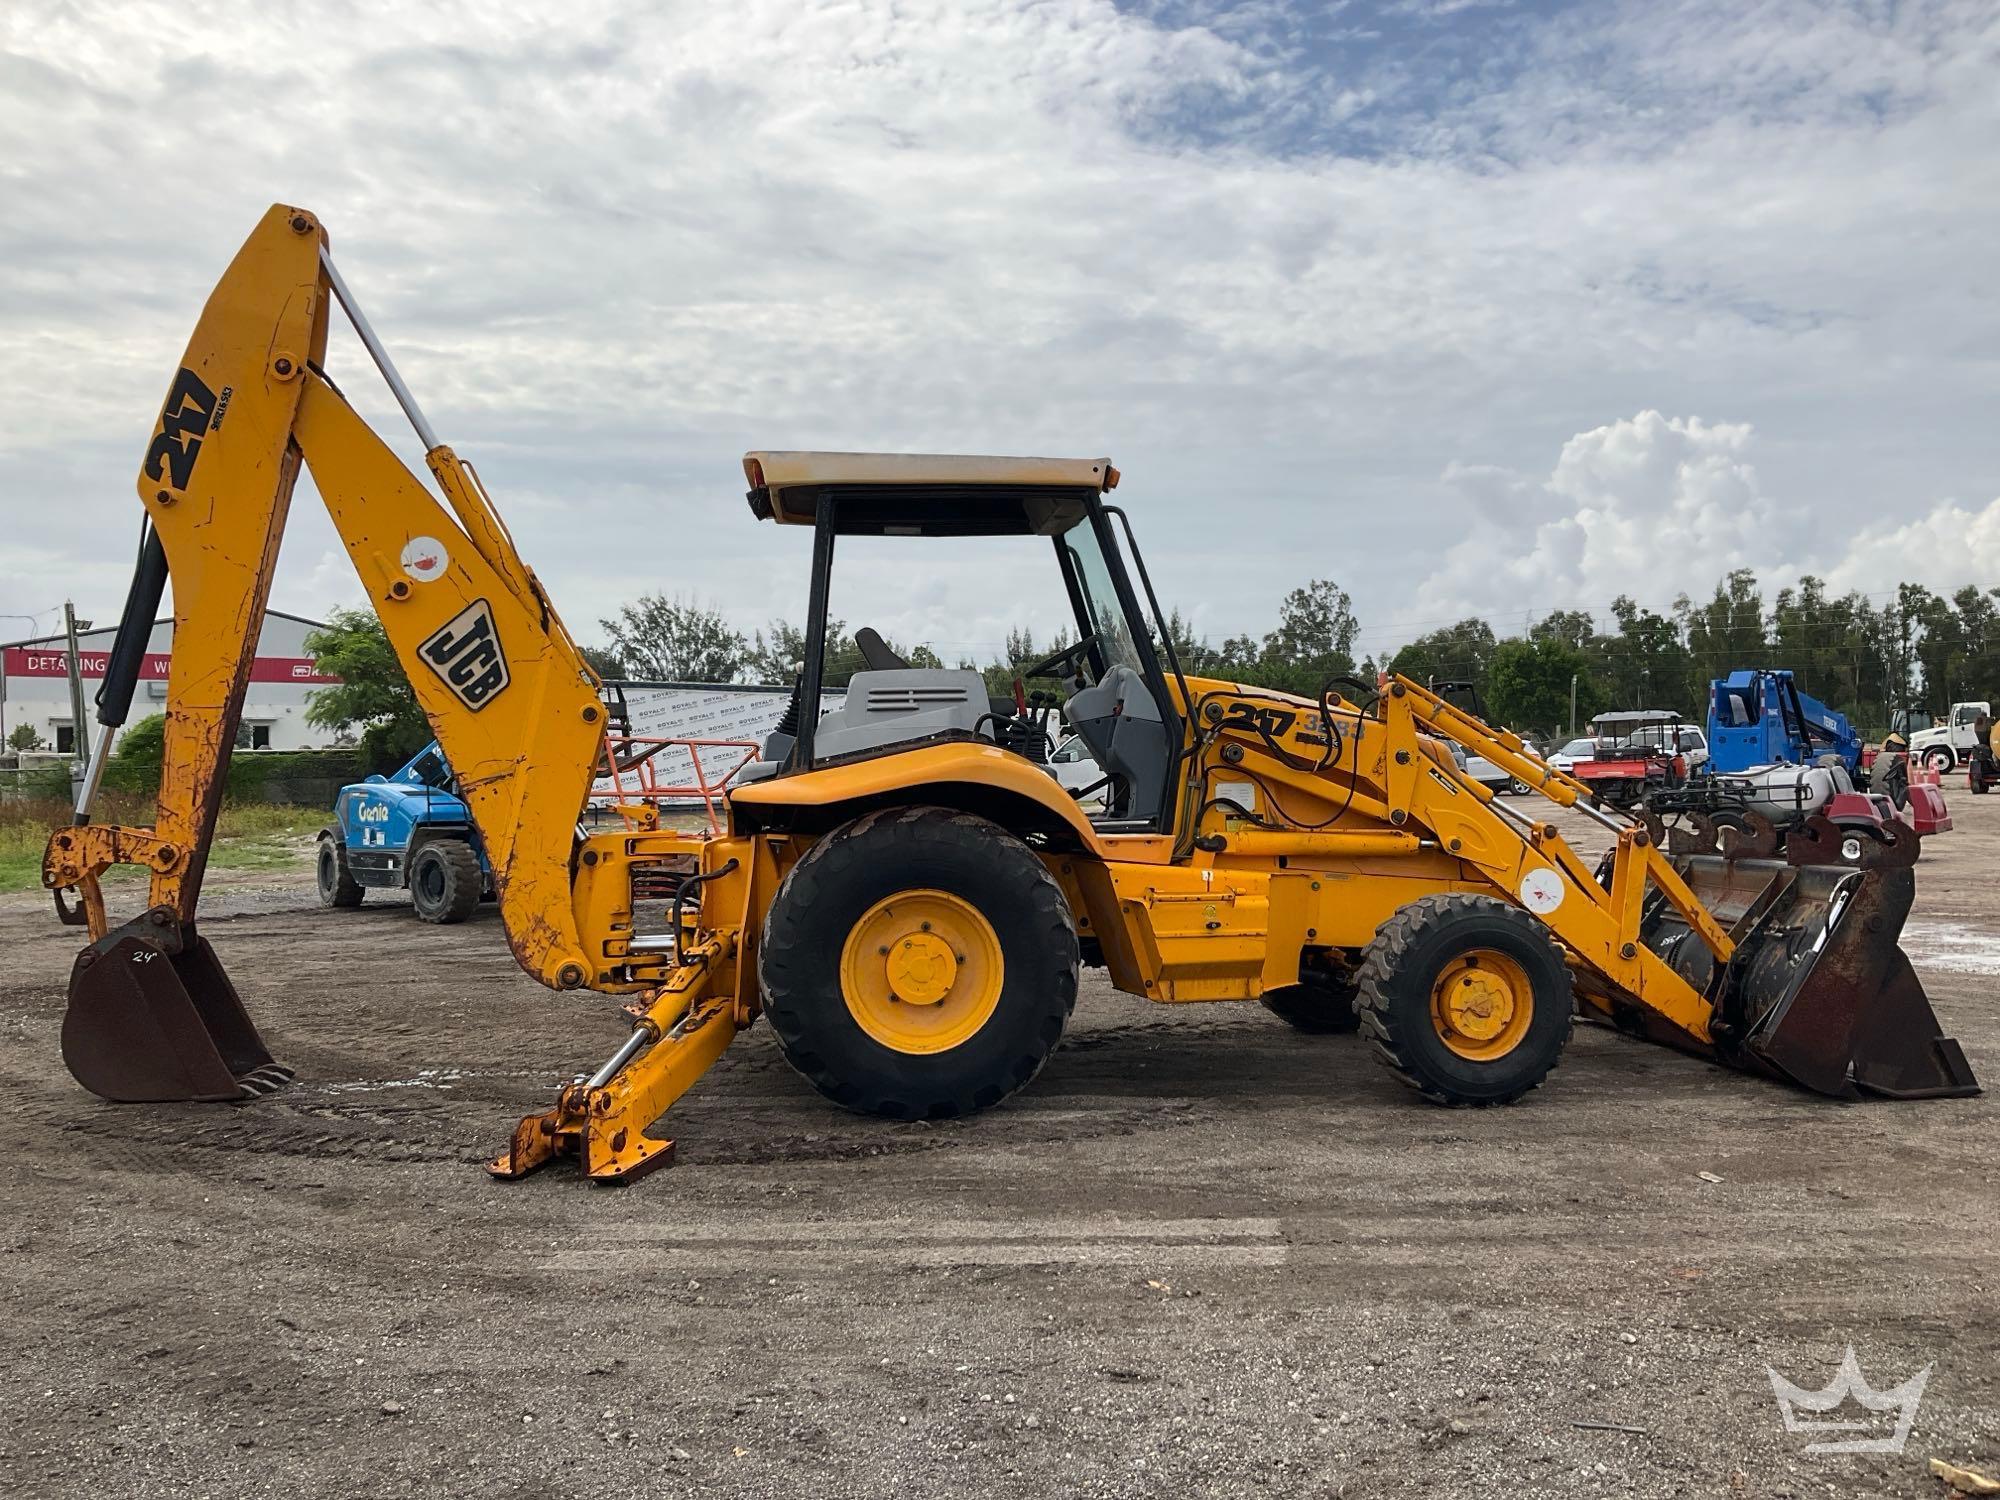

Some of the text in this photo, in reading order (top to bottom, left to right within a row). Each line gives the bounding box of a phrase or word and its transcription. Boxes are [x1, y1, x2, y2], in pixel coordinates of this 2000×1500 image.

[145, 367, 218, 492] 217
[28, 656, 106, 671] DETAING
[424, 612, 504, 704] JCB
[1228, 702, 1297, 738] 217
[358, 801, 389, 822] Genie
